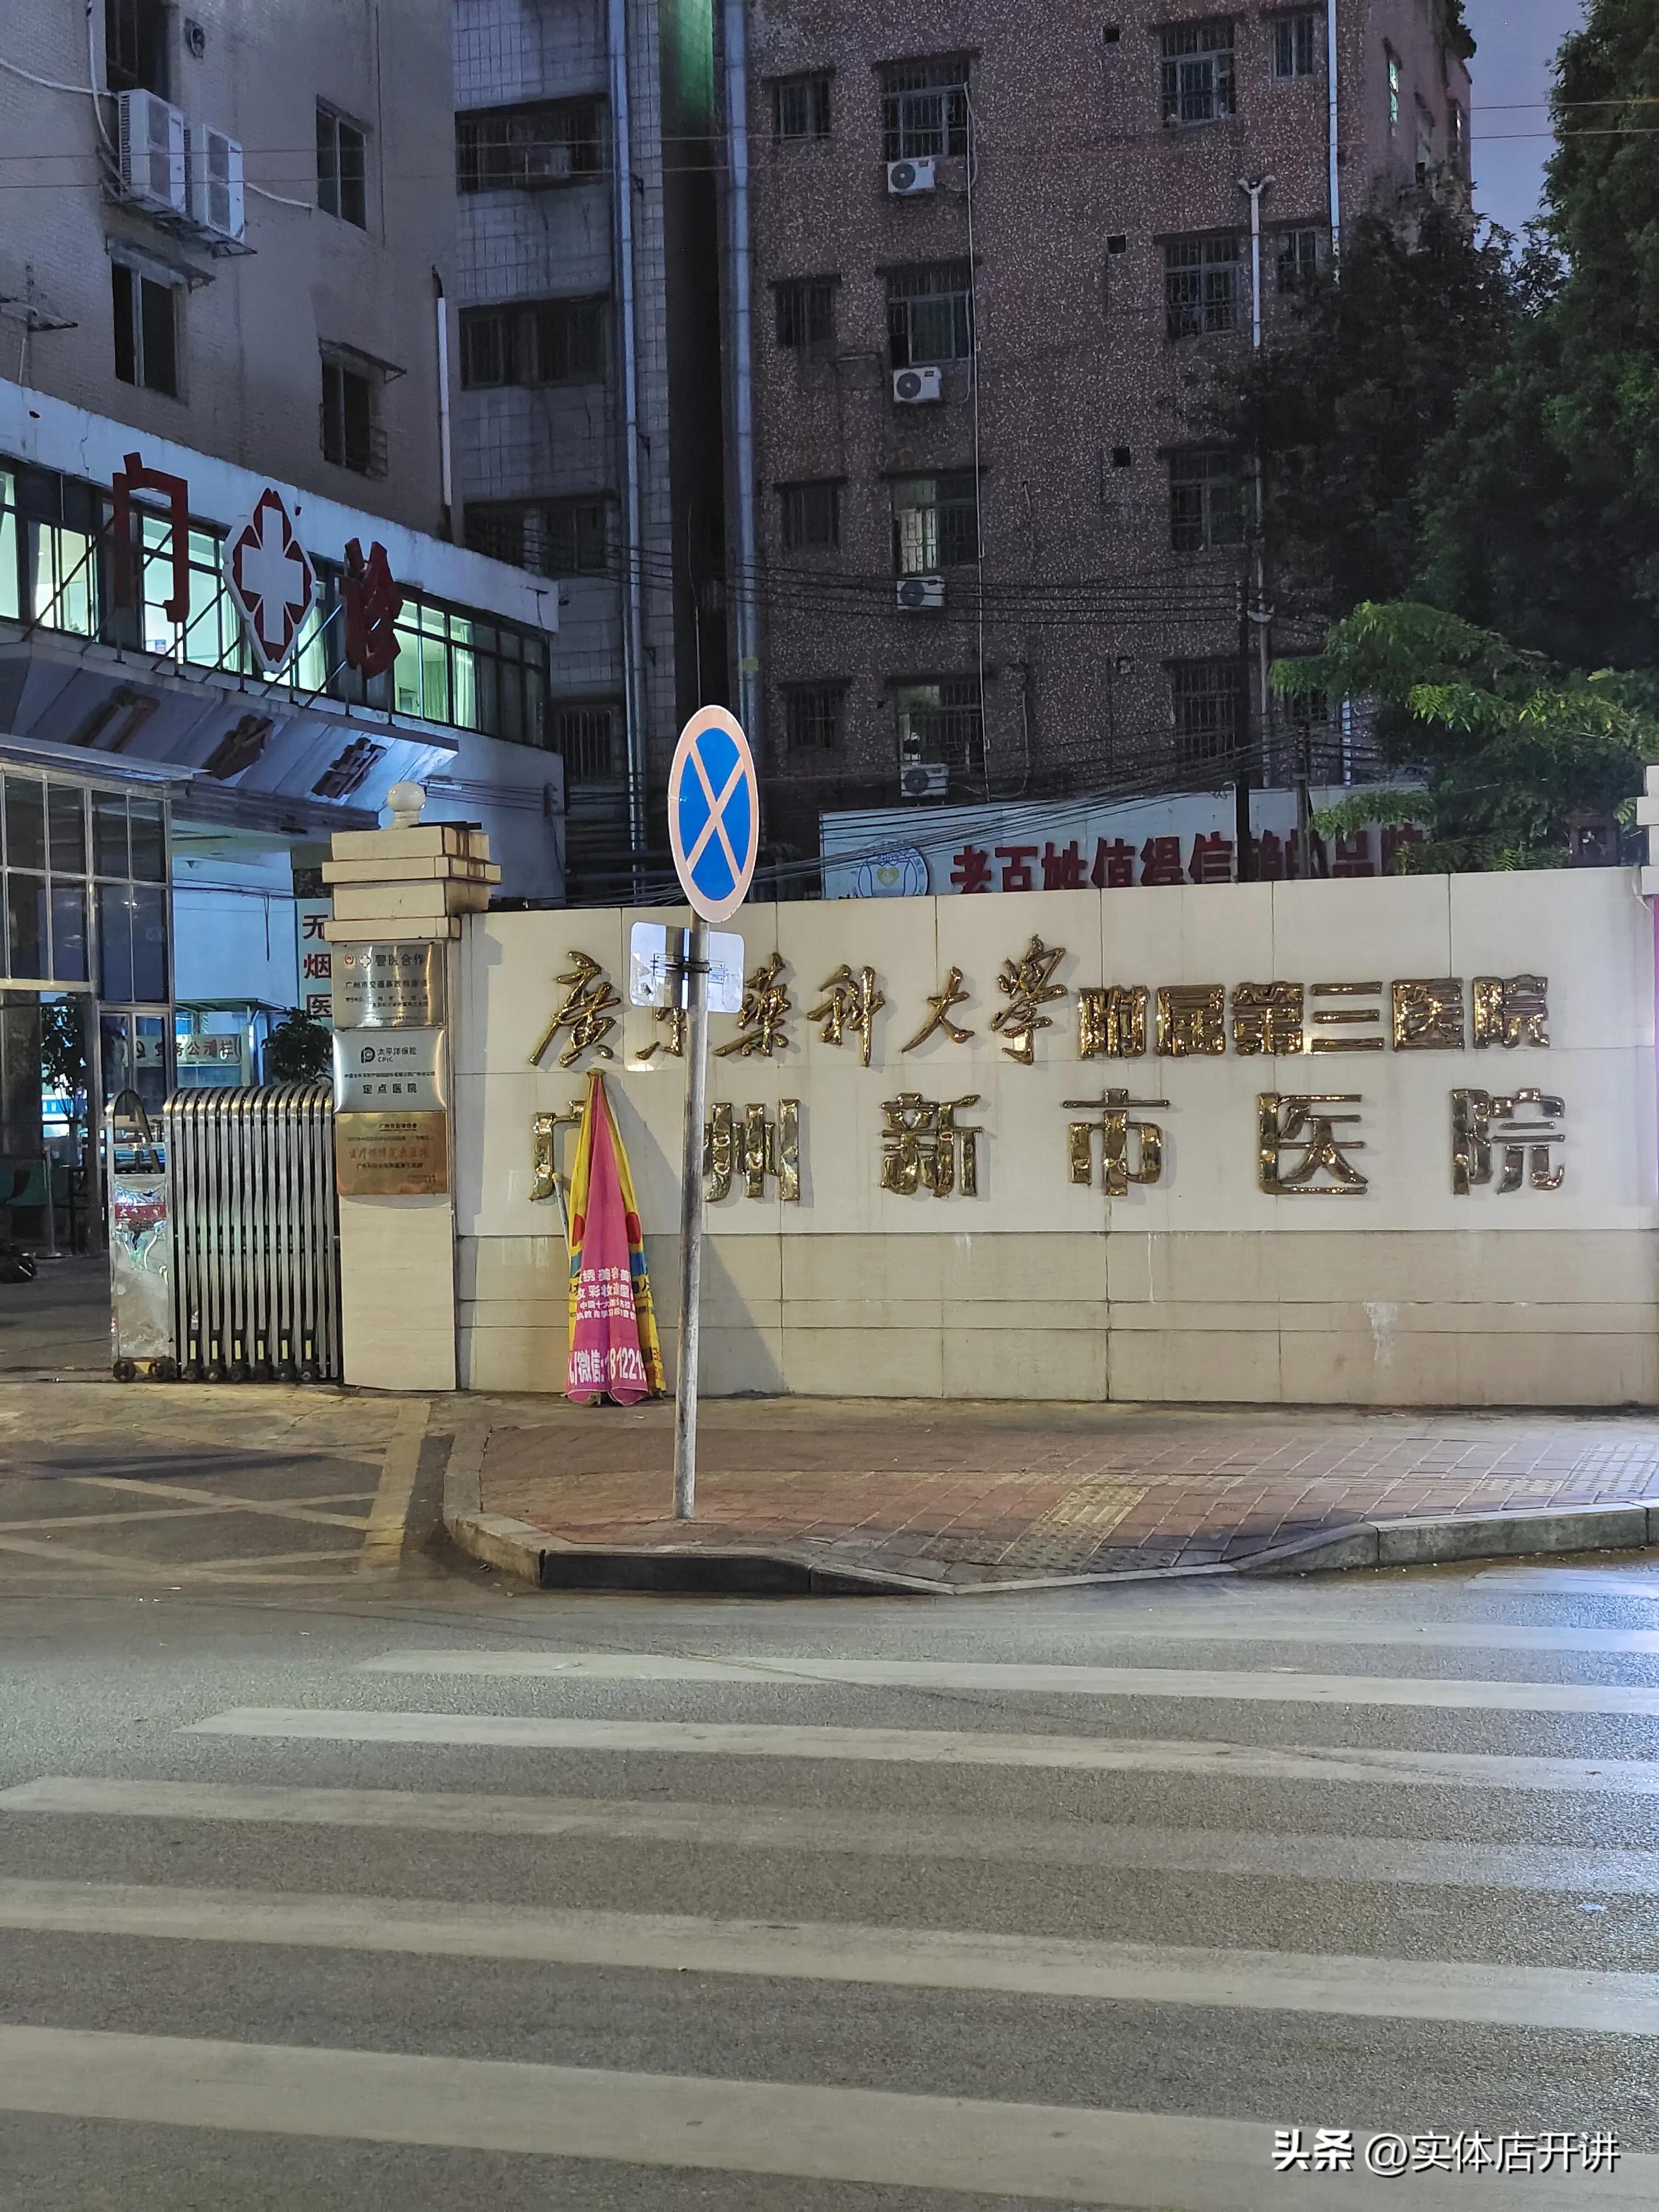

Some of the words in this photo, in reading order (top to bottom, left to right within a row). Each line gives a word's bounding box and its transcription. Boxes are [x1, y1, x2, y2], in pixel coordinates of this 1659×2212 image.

[377, 1047, 417, 1056] 太平洋保险
[363, 1082, 417, 1094] 定点医院
